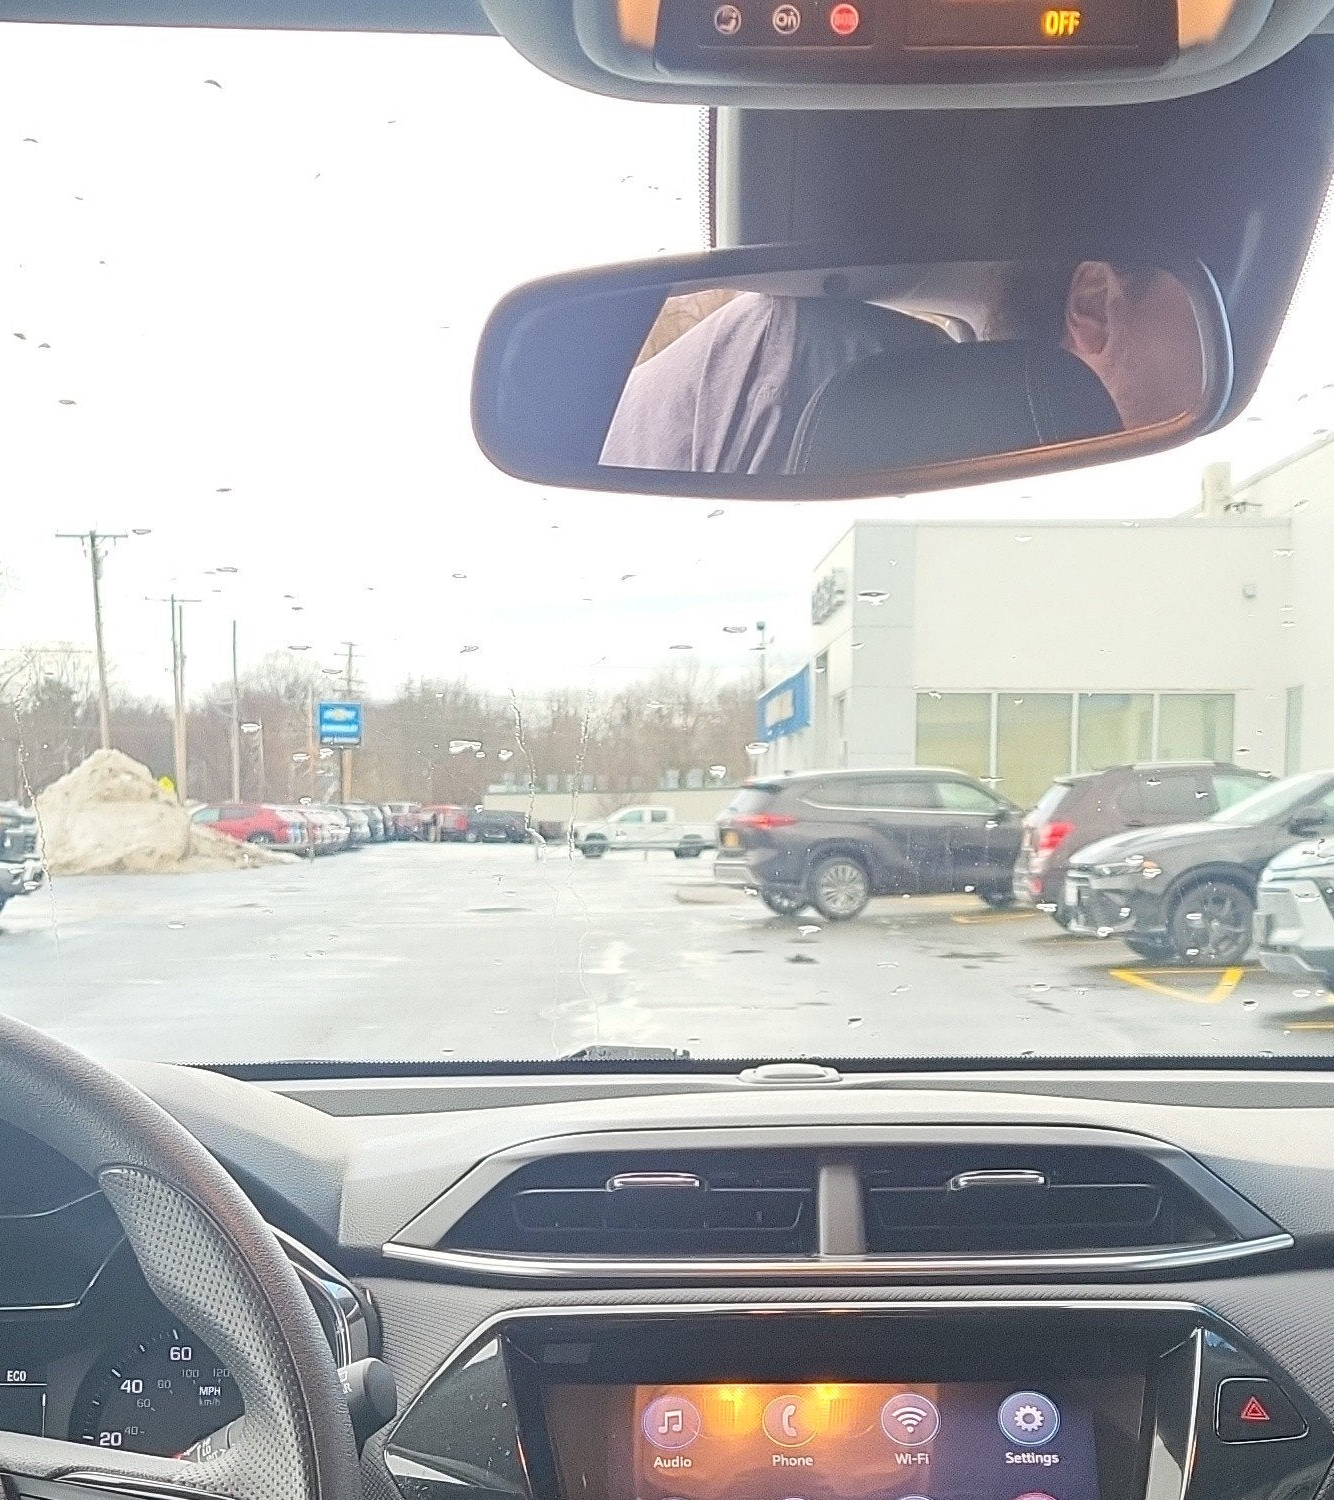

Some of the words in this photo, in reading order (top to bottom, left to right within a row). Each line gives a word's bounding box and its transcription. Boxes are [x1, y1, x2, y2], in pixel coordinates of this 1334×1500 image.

[1046, 11, 1079, 35] OFF
[170, 1347, 192, 1361] 60
[6, 1370, 27, 1382] ECO
[181, 1369, 199, 1377] 100
[213, 1369, 230, 1377] 120
[120, 1380, 143, 1394] 40
[199, 1386, 221, 1396] MPH
[137, 1399, 150, 1408] 60
[124, 1426, 138, 1435] 40
[99, 1432, 122, 1446] 20
[653, 1456, 693, 1468] Audio
[772, 1455, 814, 1467] Phone
[894, 1453, 929, 1465] Wi-Fi
[1005, 1452, 1060, 1467] Settings
